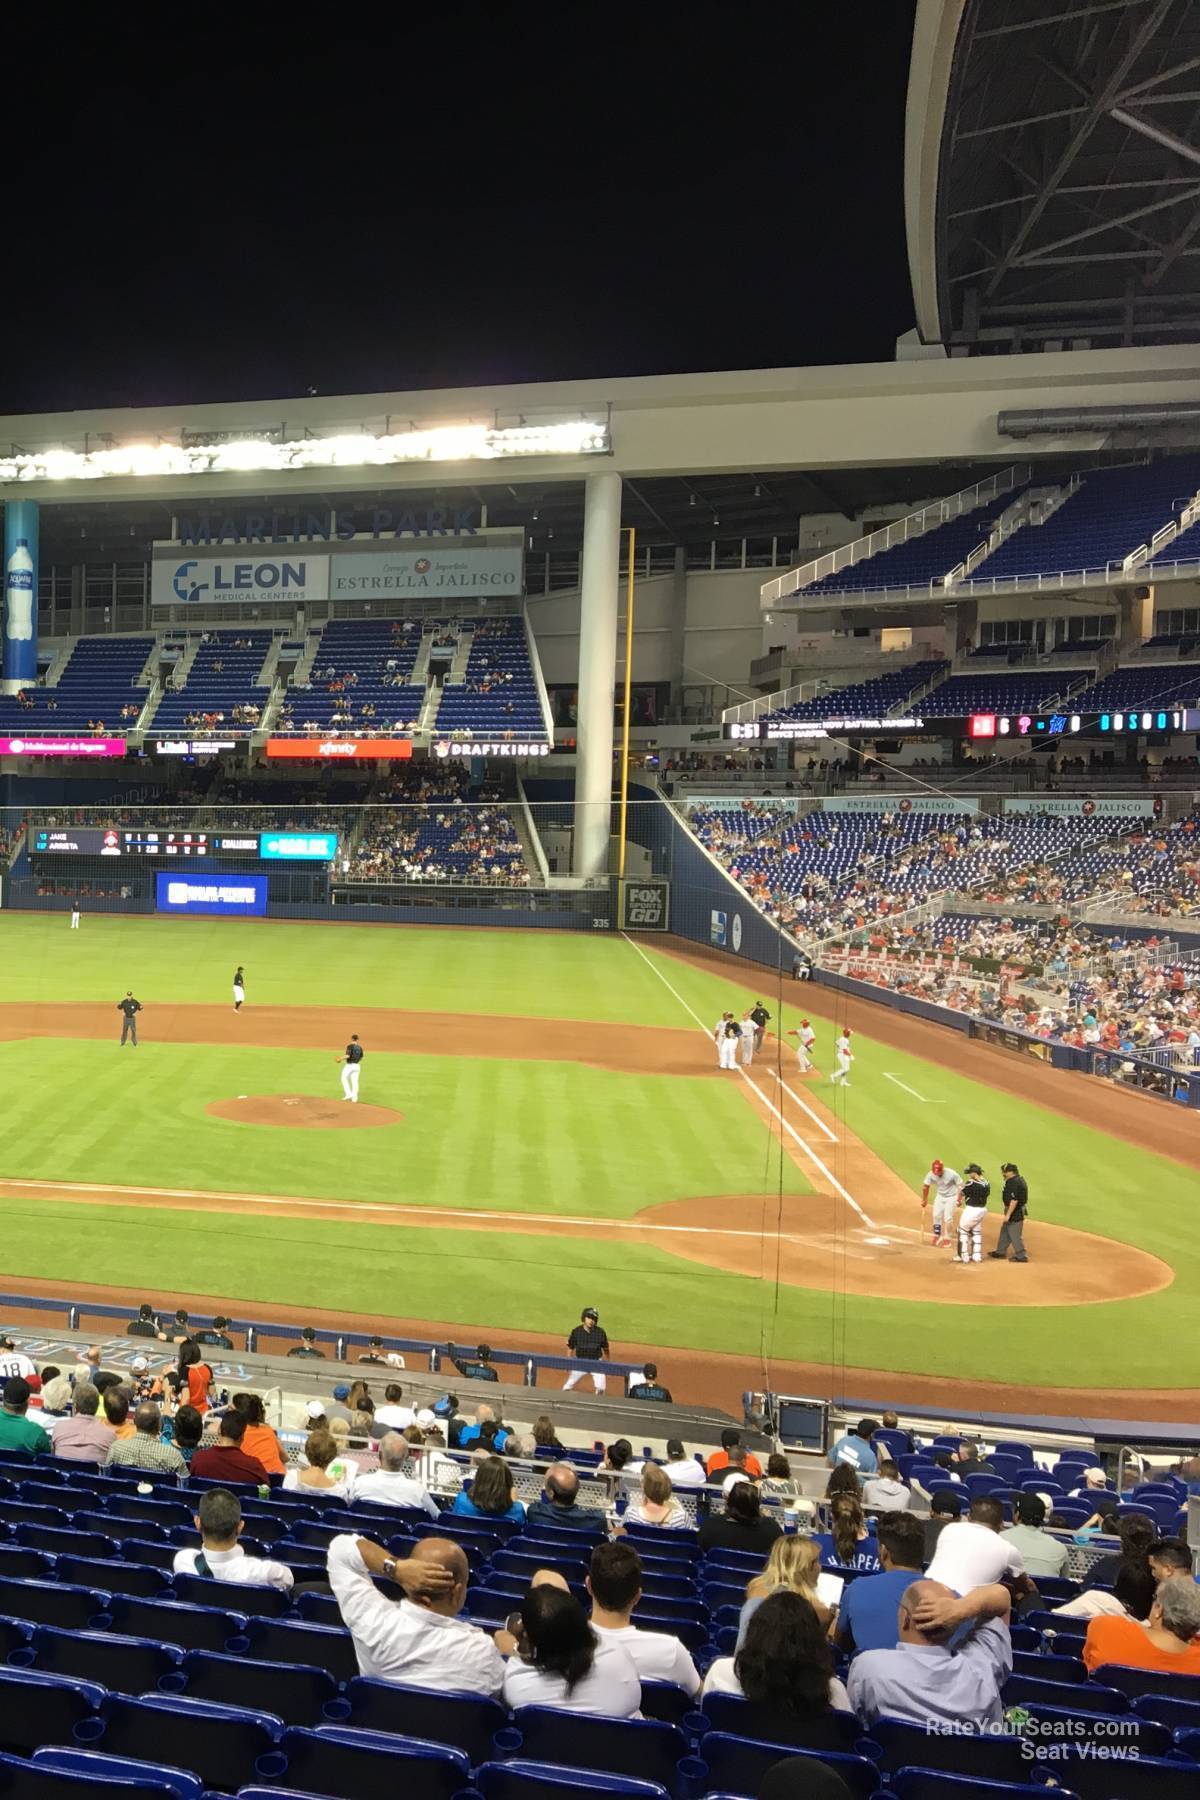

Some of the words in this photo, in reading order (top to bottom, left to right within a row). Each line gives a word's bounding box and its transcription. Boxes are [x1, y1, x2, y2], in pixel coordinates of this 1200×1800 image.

[372, 503, 478, 540] PARK
[214, 563, 306, 589] LEON
[336, 575, 429, 590] ESTRELLA
[436, 573, 517, 587] JALISCO
[214, 593, 261, 601] MEDICAL
[265, 591, 305, 600] CENTERS
[319, 742, 357, 755] xfinity
[452, 744, 548, 756] DRAFTKINGS
[629, 889, 661, 902] FOX
[593, 918, 609, 928] 335
[3, 1363, 21, 1378] 18
